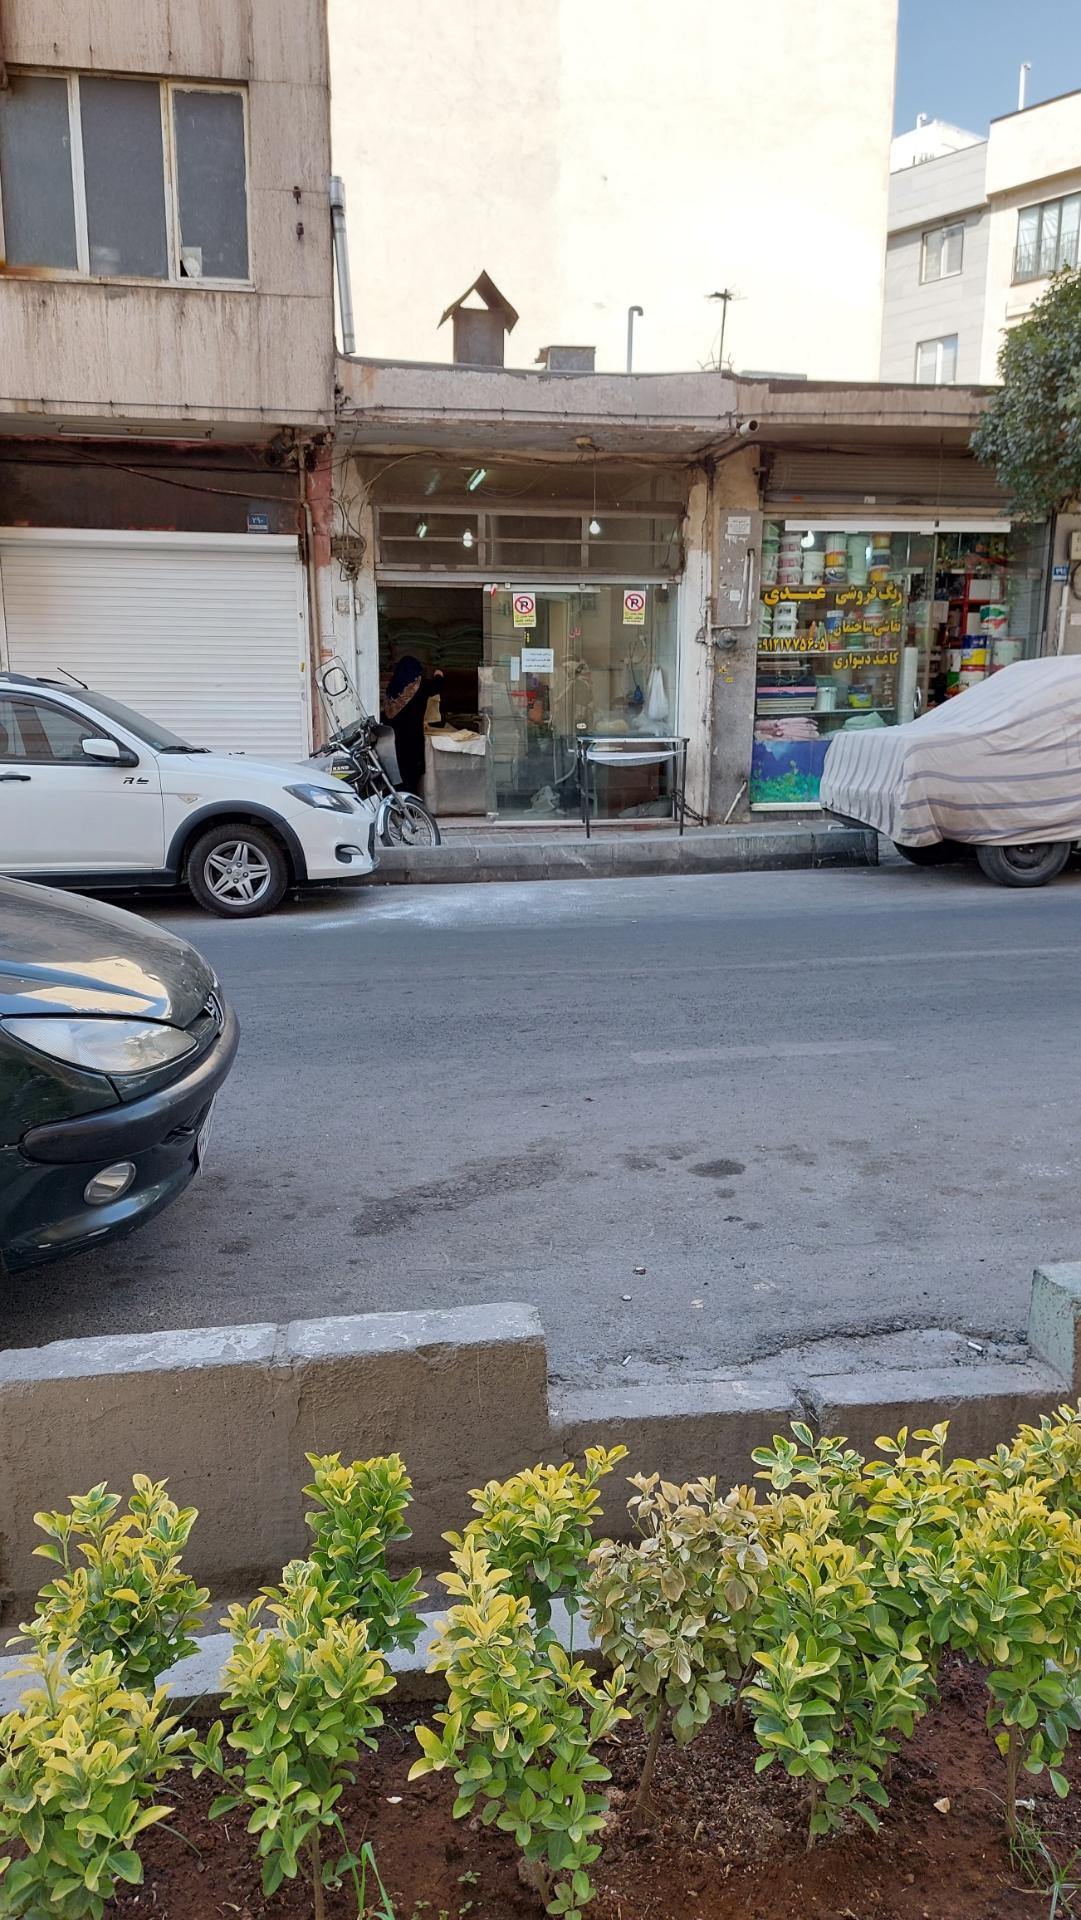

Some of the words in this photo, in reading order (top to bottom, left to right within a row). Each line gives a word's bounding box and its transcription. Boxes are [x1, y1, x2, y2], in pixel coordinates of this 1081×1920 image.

[764, 586, 826, 606] عبدی
[835, 582, 877, 605] فروشی
[879, 582, 903, 606] رنگ
[833, 618, 873, 637] ساختمان
[874, 618, 901, 637] نقاشی
[832, 651, 871, 670] دیواری
[872, 649, 900, 666] کاغذ
